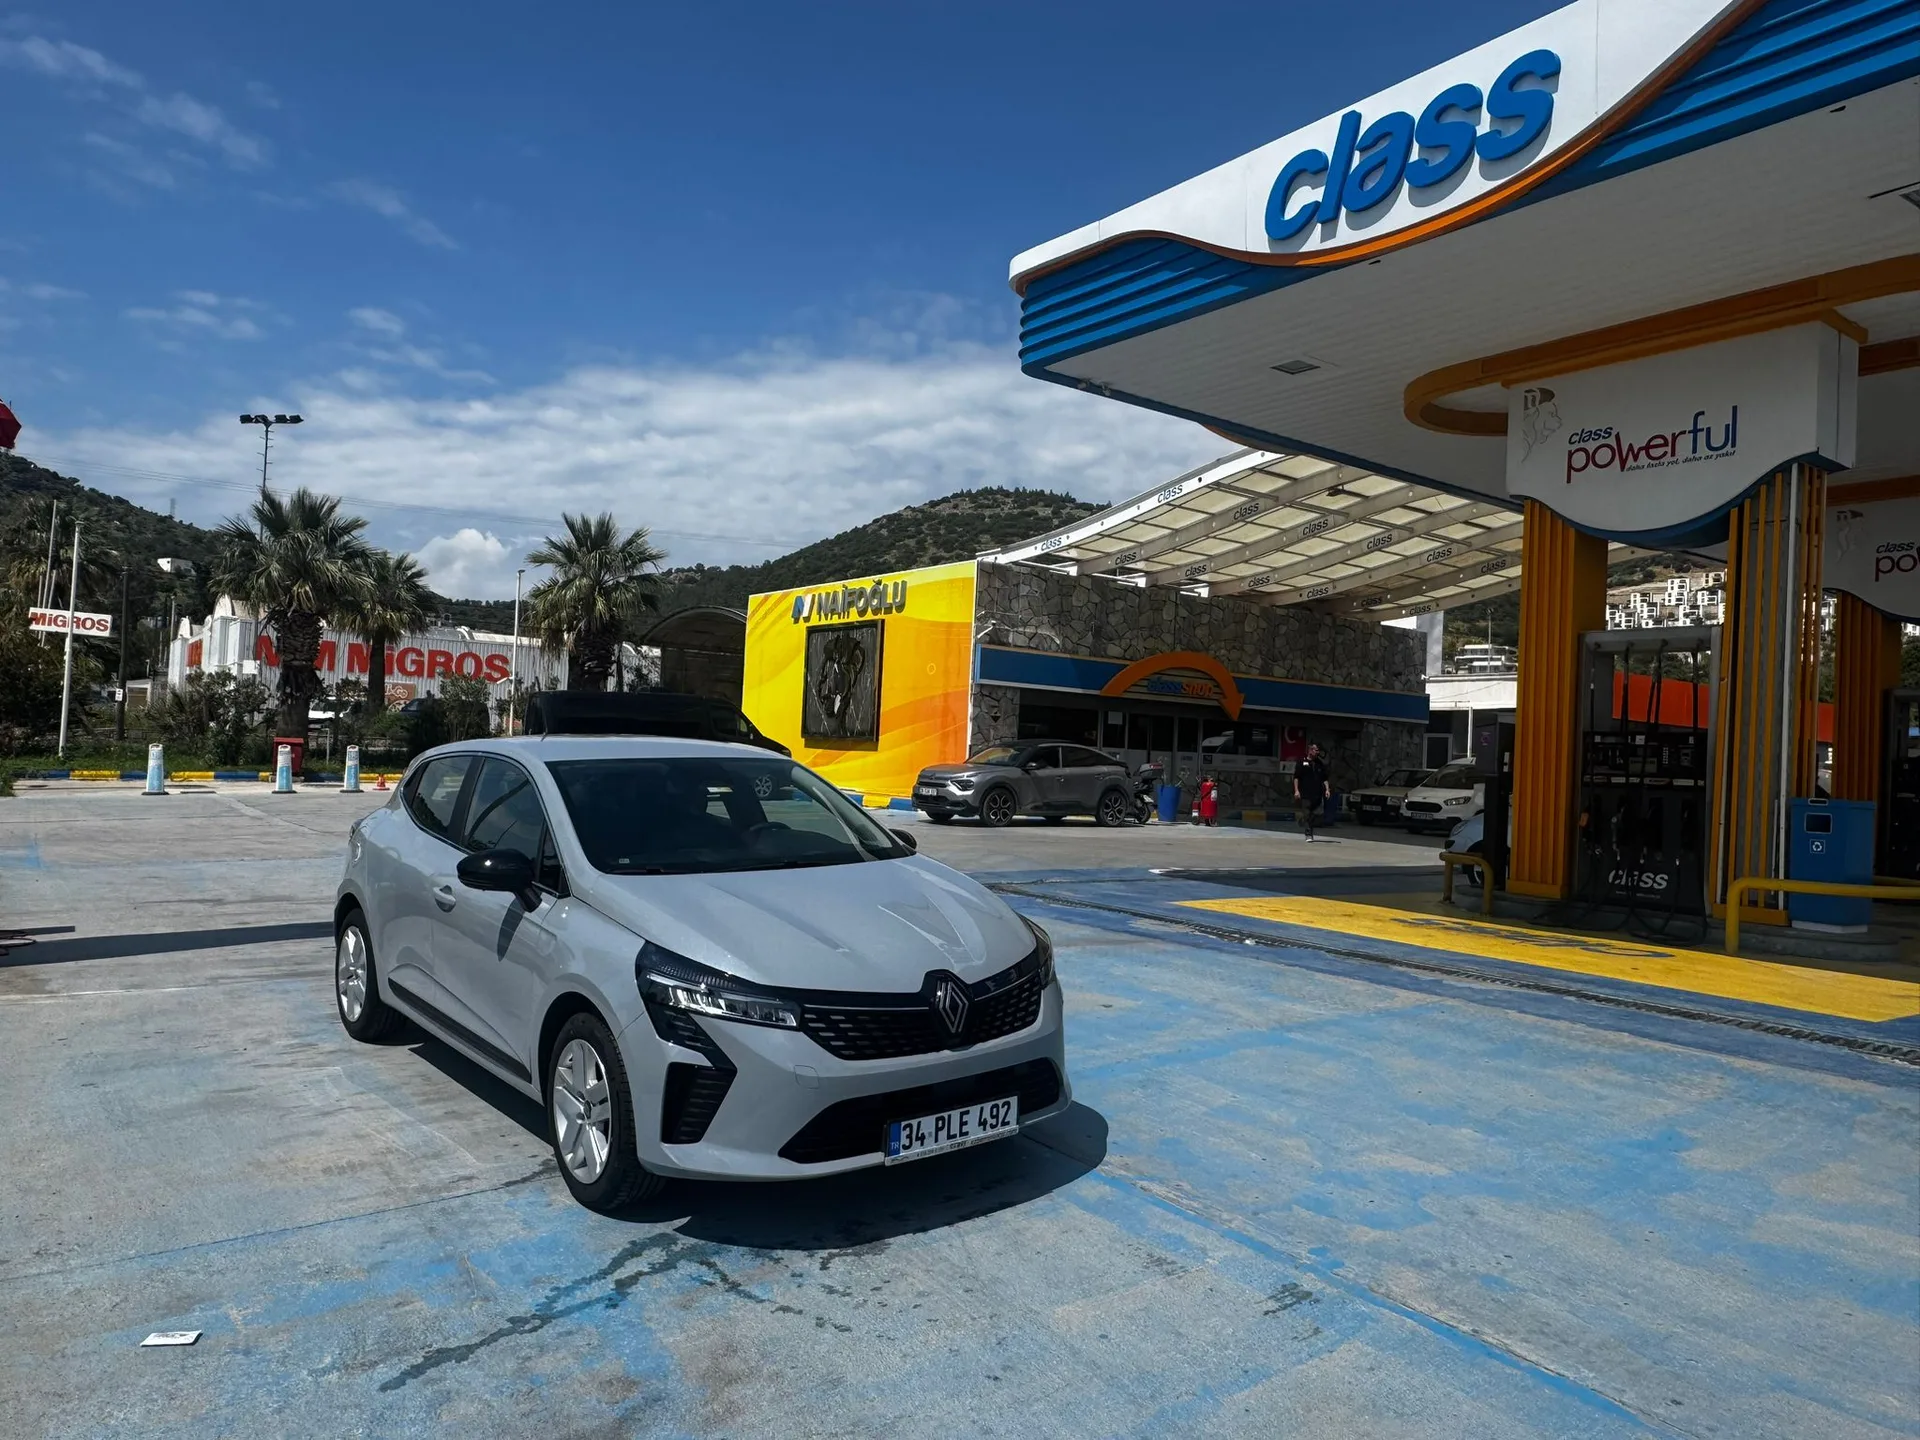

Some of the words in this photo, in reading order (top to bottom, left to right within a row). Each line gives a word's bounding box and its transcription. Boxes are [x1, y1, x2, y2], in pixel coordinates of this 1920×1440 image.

[1265, 49, 1562, 240] class
[1568, 426, 1613, 445] class
[1566, 405, 1738, 484] powerful
[1157, 483, 1183, 504] class
[1234, 502, 1259, 520] class
[1302, 518, 1329, 537] class
[1041, 536, 1063, 552] class
[1366, 533, 1393, 551] class
[1876, 541, 1915, 554] class
[1115, 550, 1137, 566] class
[1426, 547, 1453, 564] class
[1875, 545, 1920, 582] po
[1184, 564, 1207, 578] class
[1480, 558, 1507, 574] class
[1247, 575, 1271, 588] class
[816, 579, 907, 618] NAİFOĞLU
[1306, 585, 1329, 600] class
[1361, 595, 1383, 608] class
[1409, 603, 1432, 616] class
[901, 1121, 926, 1151] 34
[934, 1110, 970, 1143] PLE
[978, 1101, 1011, 1131] 492
[890, 1141, 900, 1150] TR
